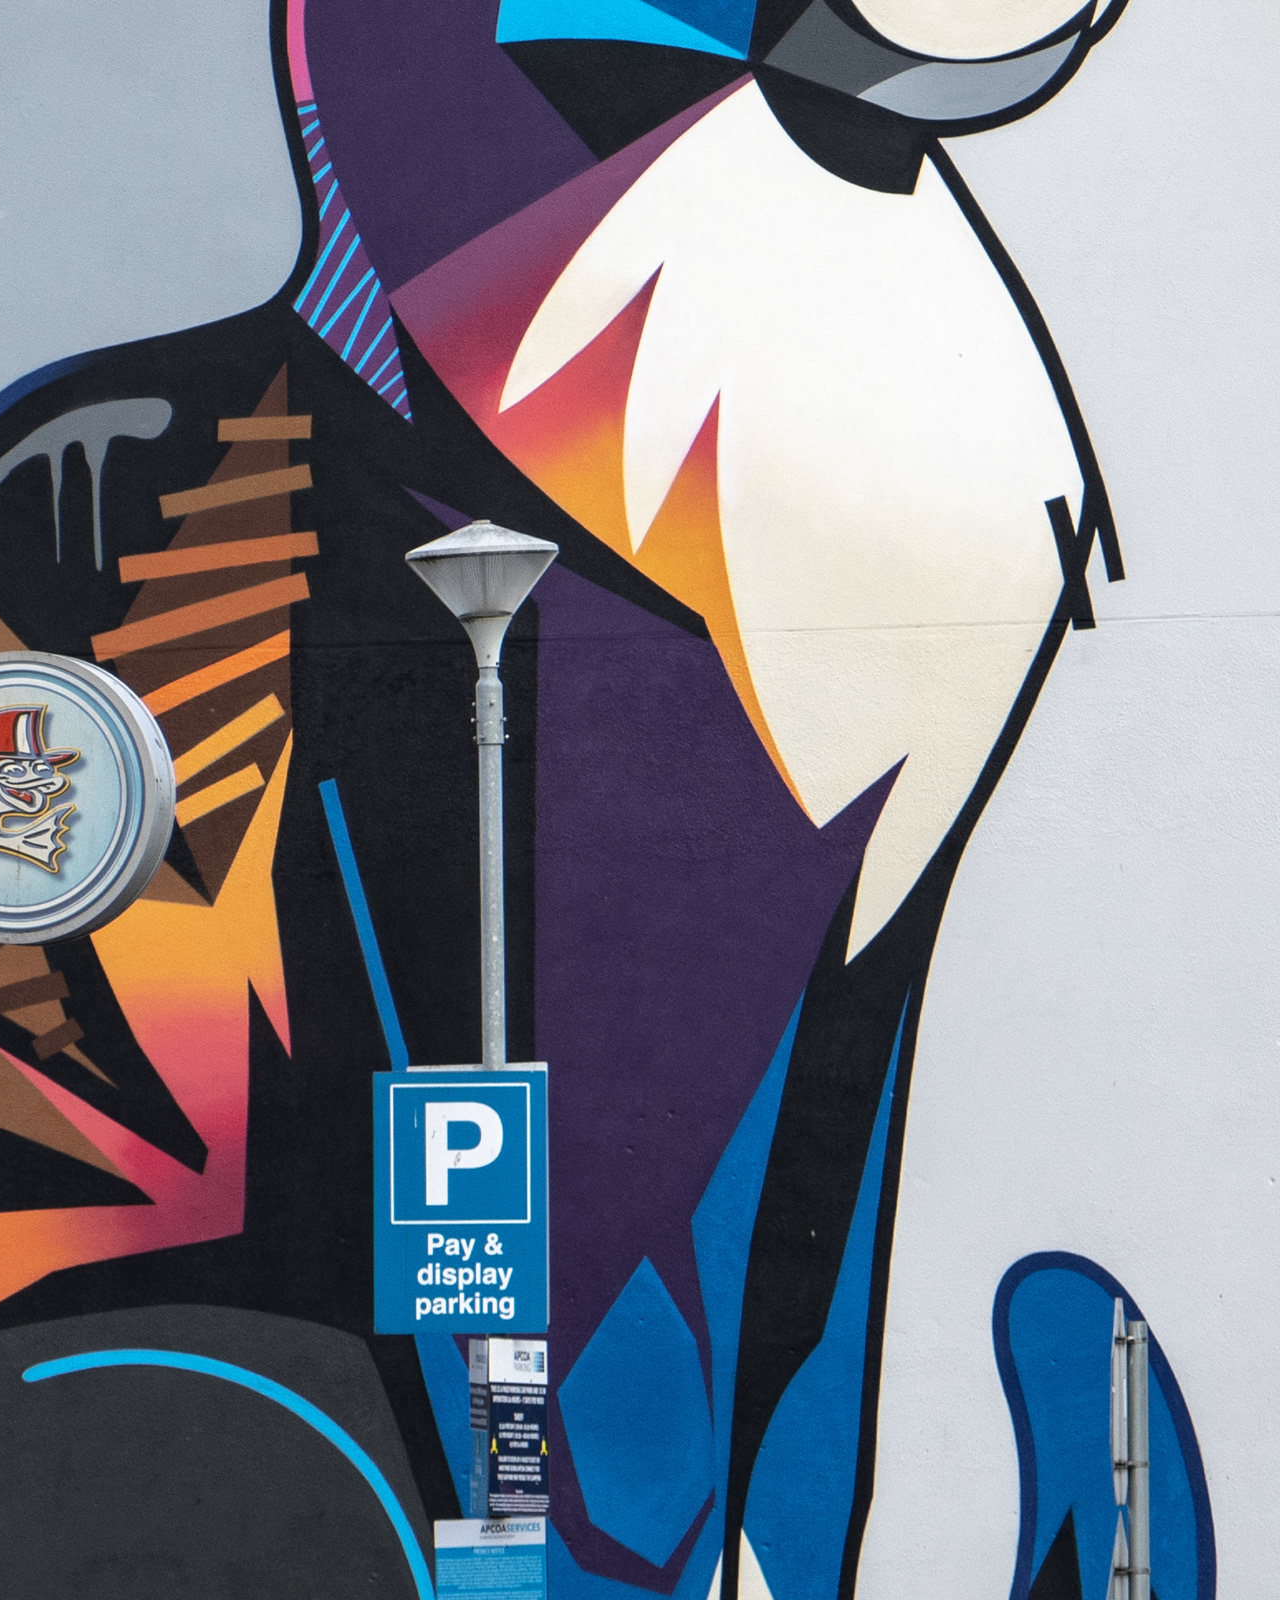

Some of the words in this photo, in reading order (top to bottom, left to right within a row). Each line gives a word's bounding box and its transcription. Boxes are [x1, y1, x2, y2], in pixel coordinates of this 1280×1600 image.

[425, 1102, 503, 1205] P
[427, 1233, 475, 1260] Pay
[484, 1233, 503, 1255] &
[417, 1263, 513, 1290] display
[415, 1293, 515, 1320] parking
